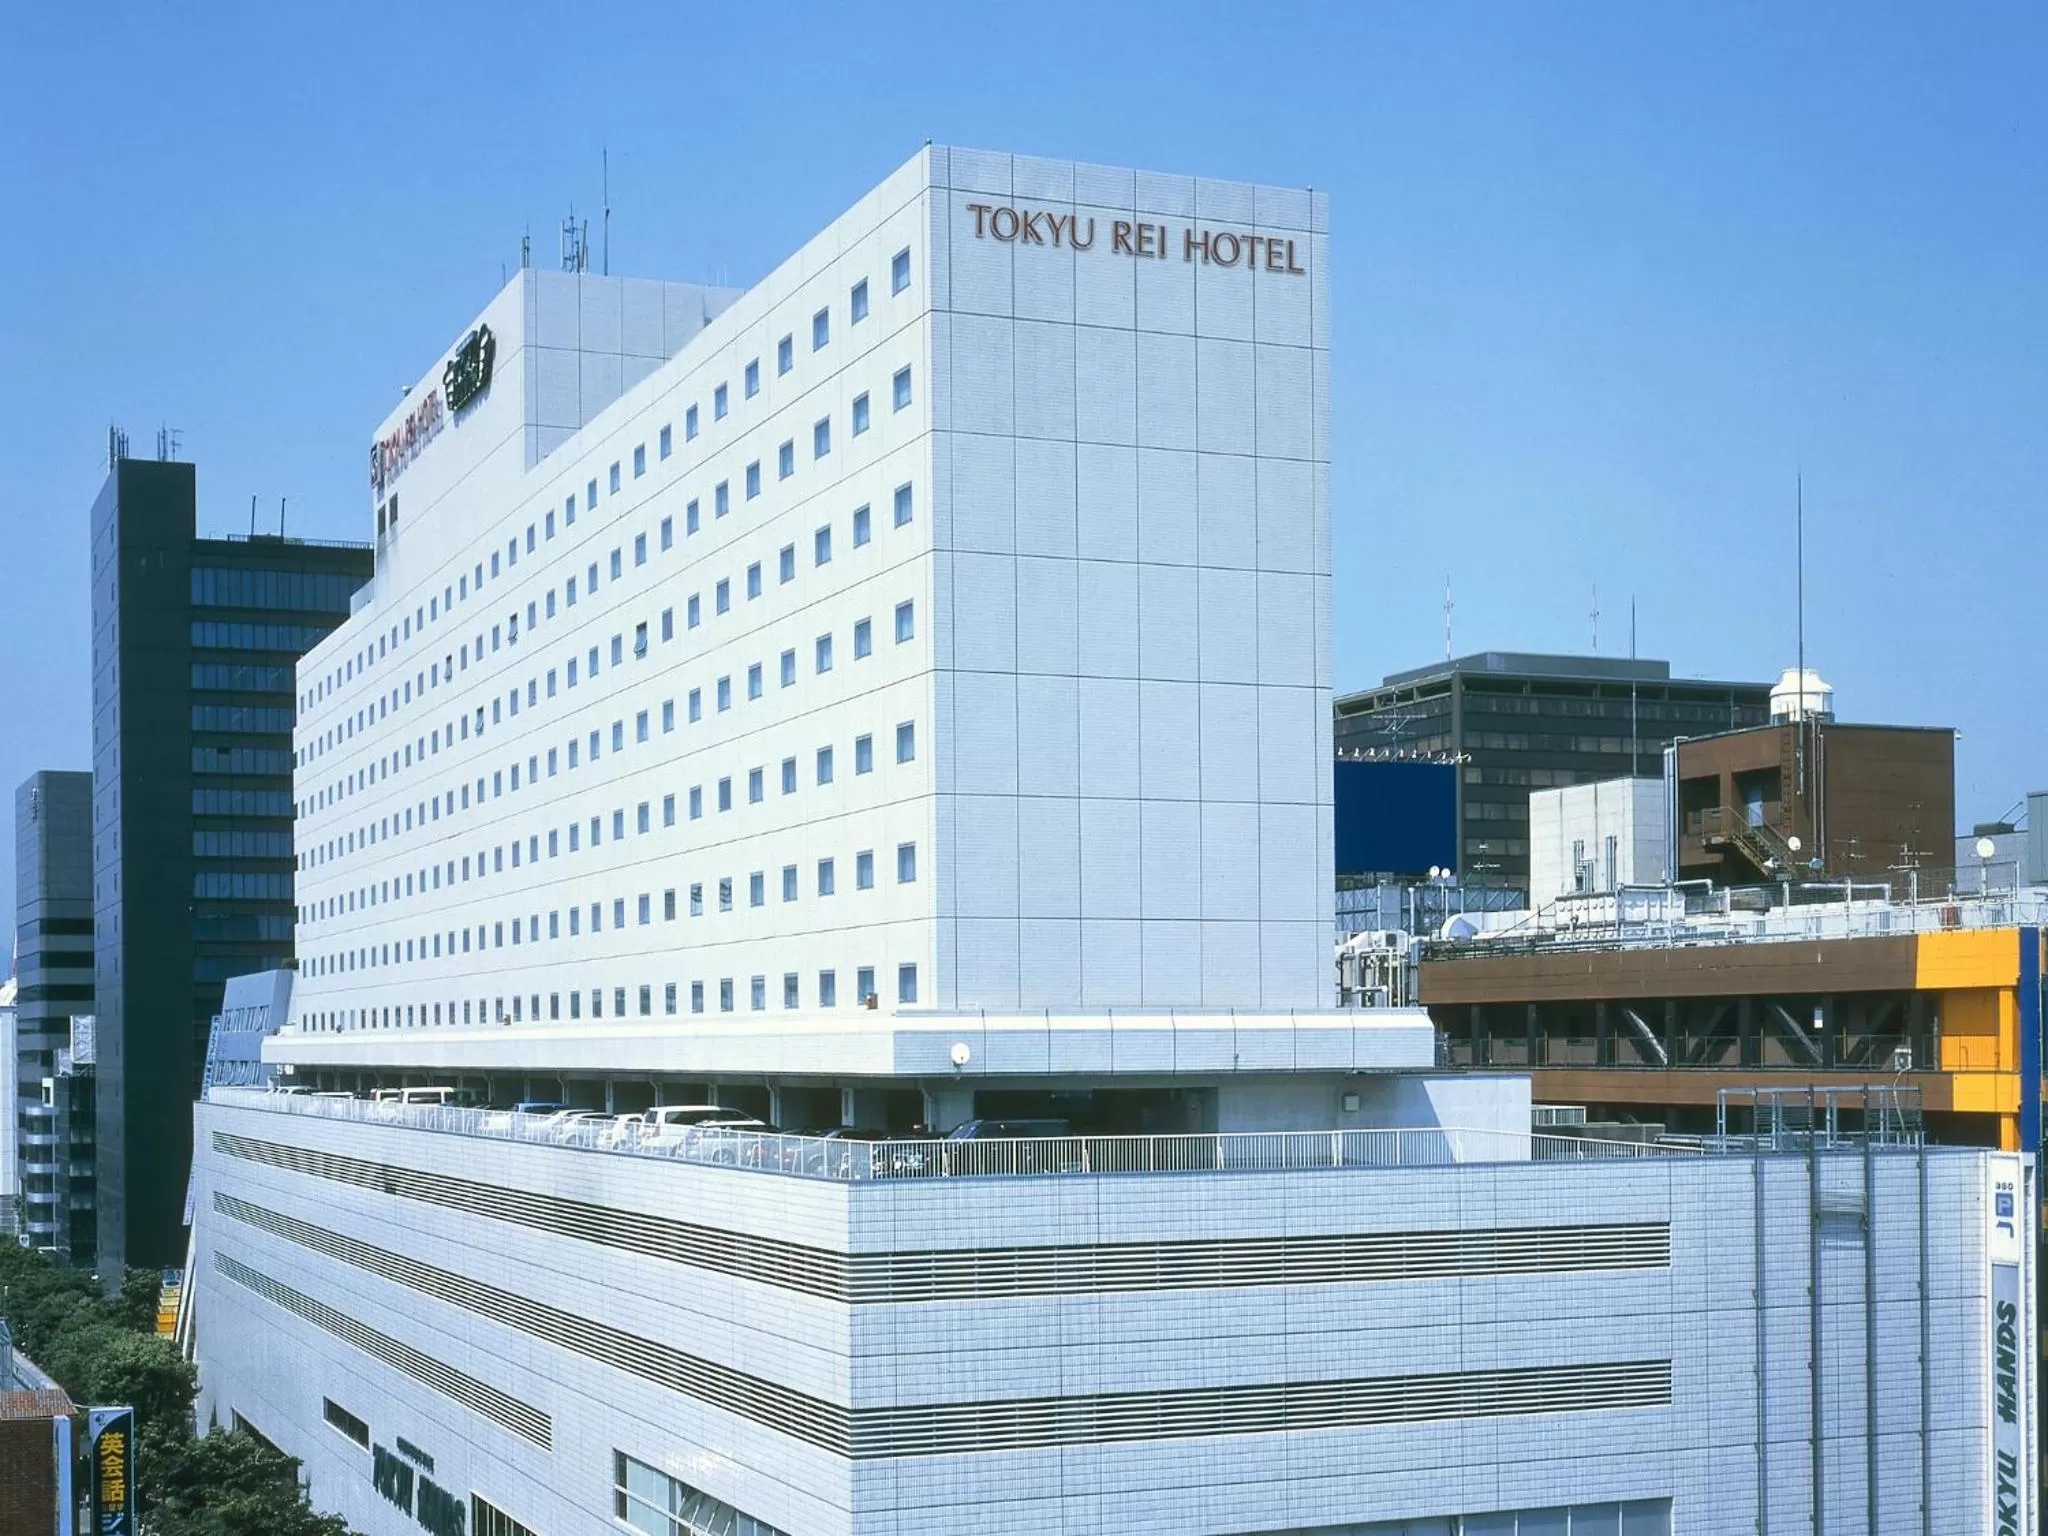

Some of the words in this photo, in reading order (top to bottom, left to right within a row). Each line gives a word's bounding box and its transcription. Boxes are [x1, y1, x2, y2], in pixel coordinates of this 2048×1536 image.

[966, 203, 1095, 251] TOKYU
[1112, 220, 1168, 259] REI
[1182, 228, 1306, 275] HOTEL
[1996, 1300, 2017, 1424] HANDS
[101, 1432, 125, 1502] 英会話
